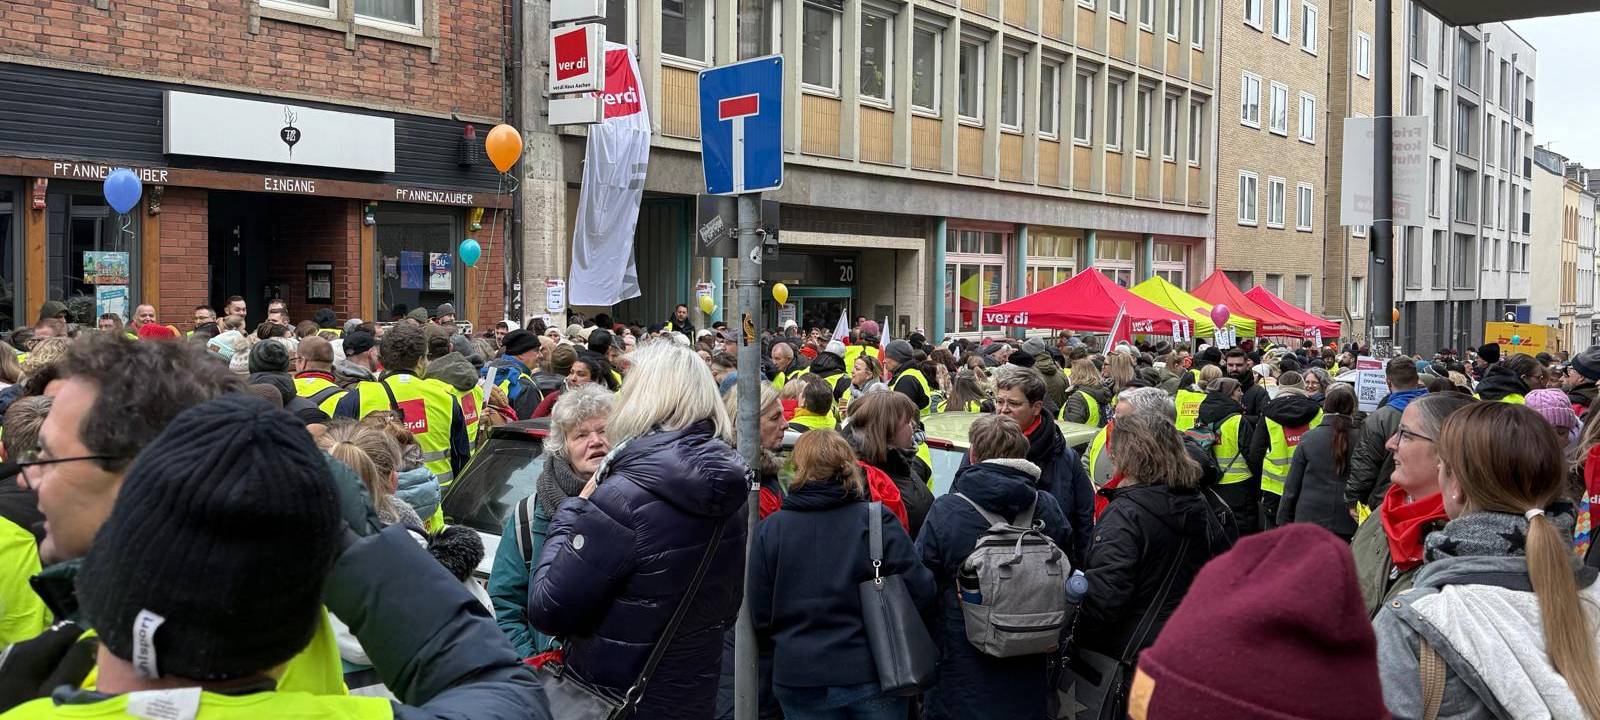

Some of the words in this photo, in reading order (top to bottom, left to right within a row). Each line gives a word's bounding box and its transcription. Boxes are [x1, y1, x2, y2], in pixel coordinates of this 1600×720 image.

[53, 162, 168, 182] PFANNEUBER
[264, 177, 315, 193] EINGANG
[396, 188, 473, 204] PFANNENZAUBER
[839, 265, 854, 282] 20
